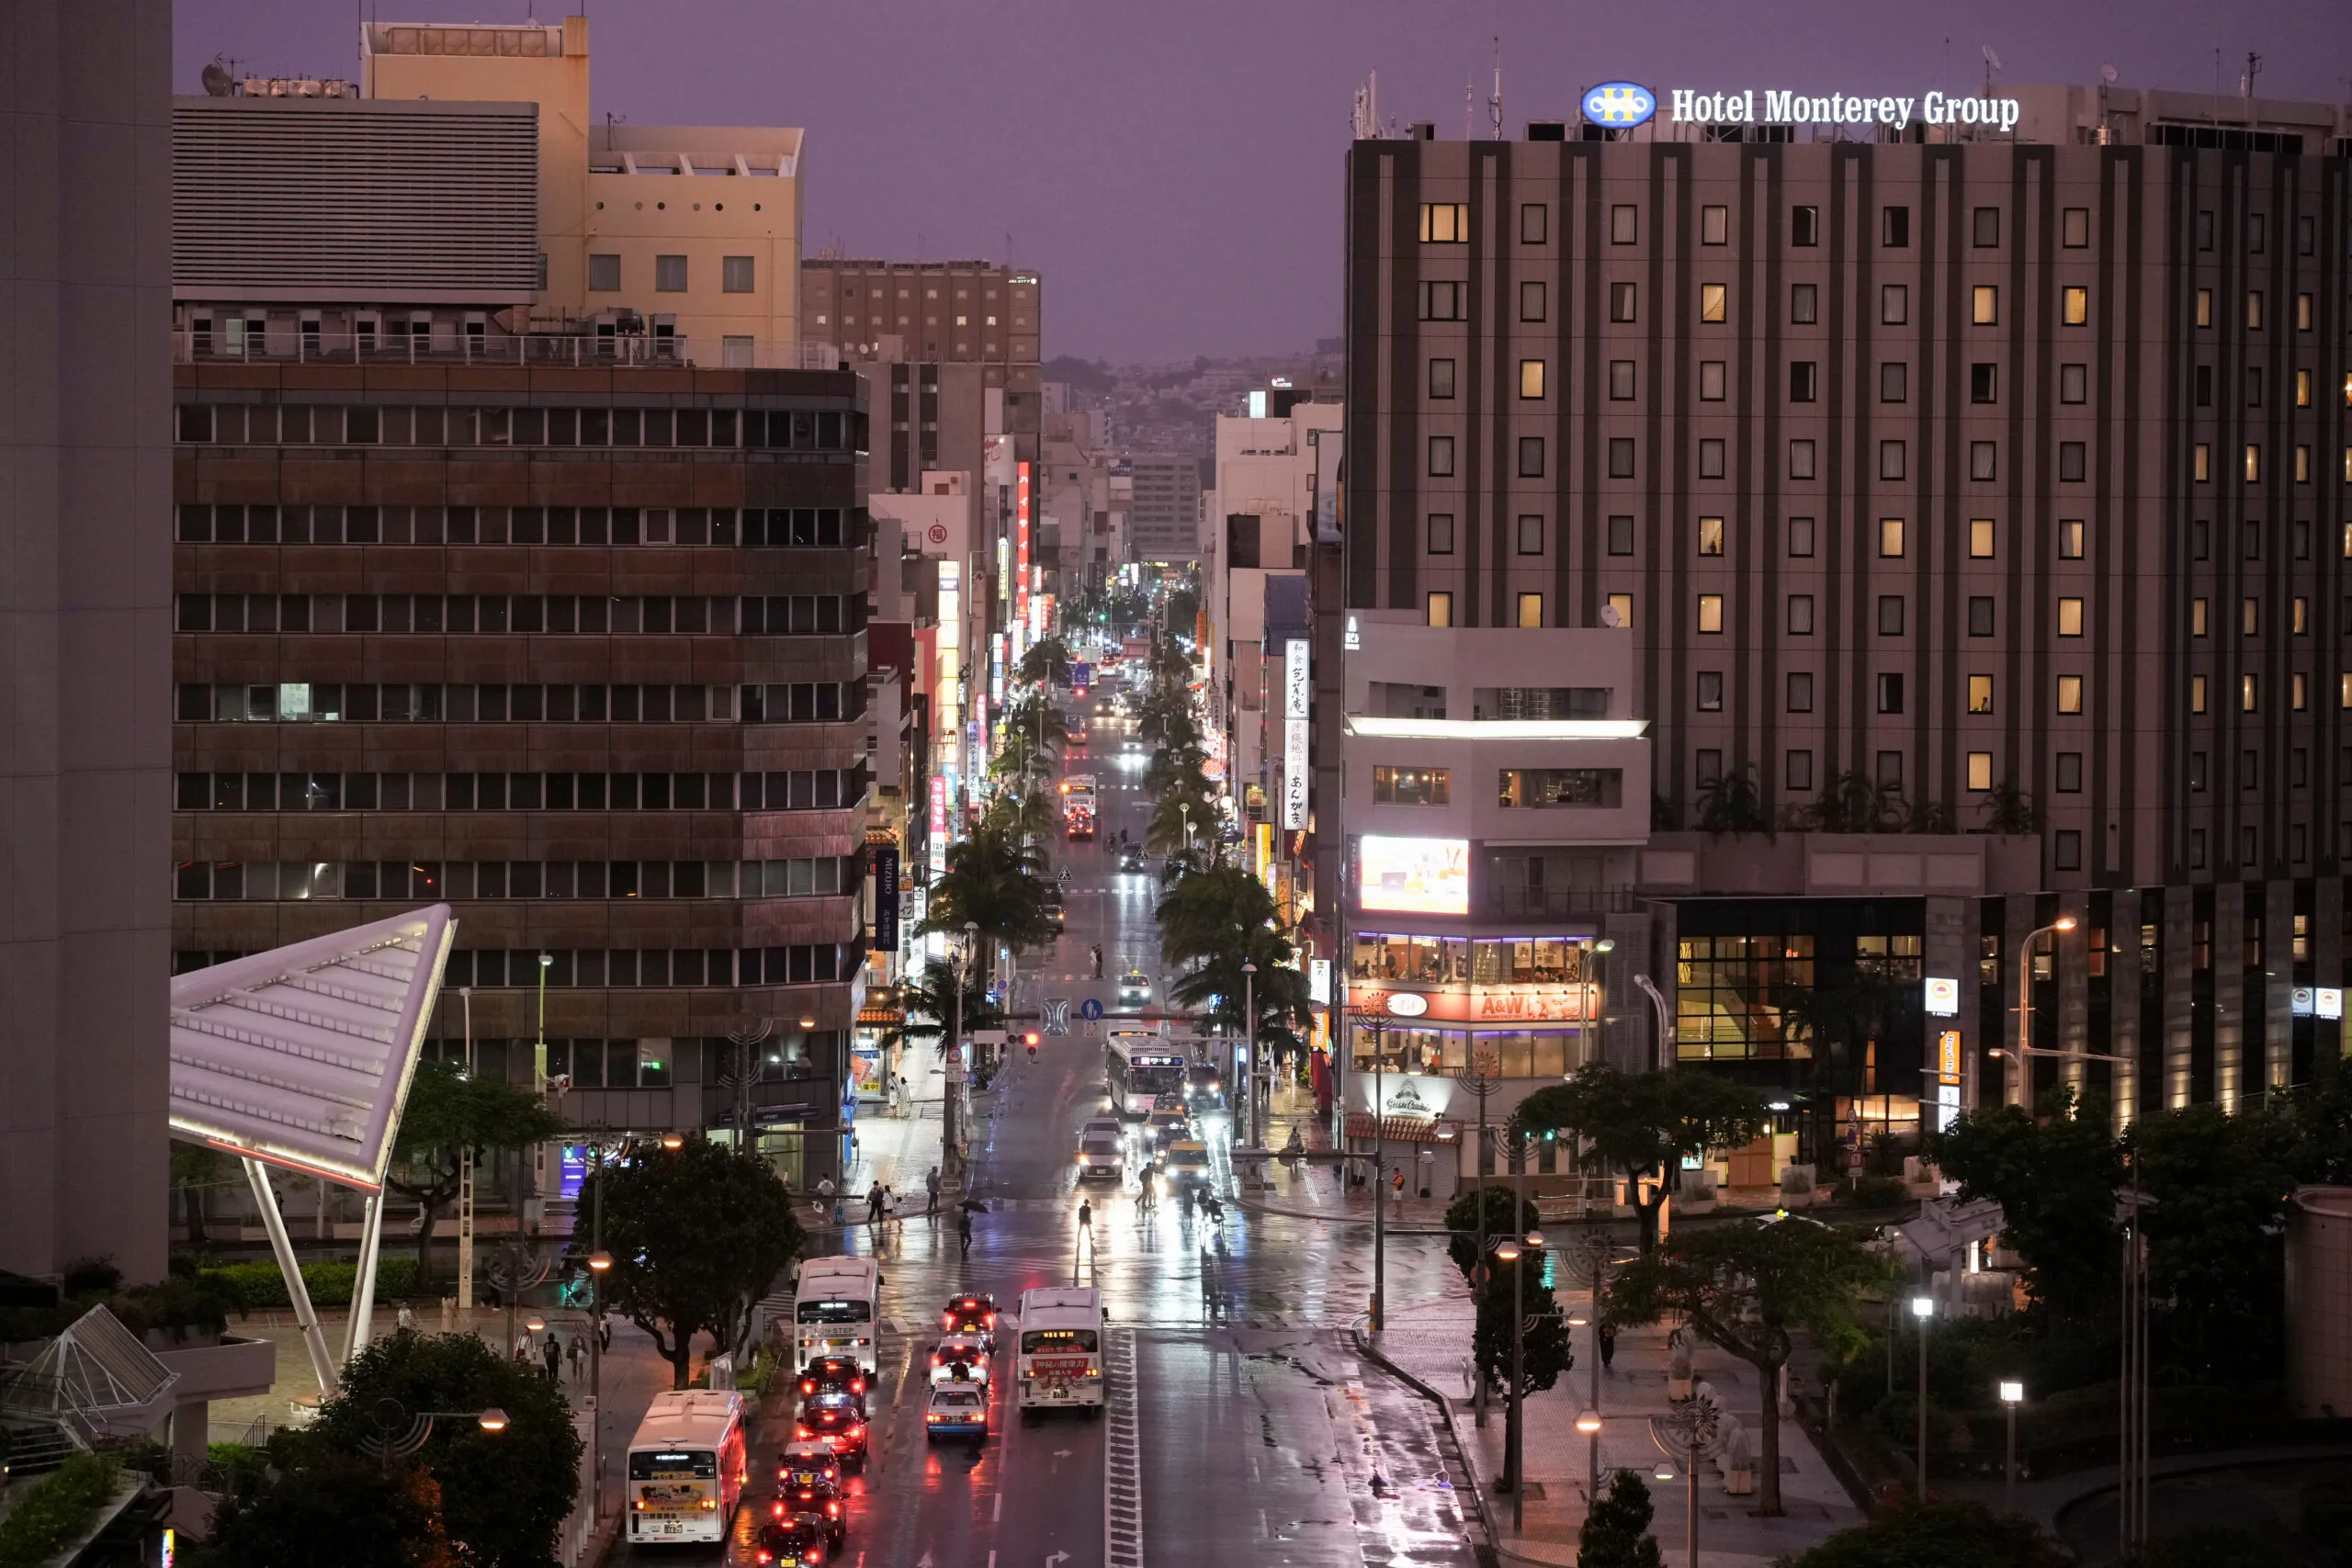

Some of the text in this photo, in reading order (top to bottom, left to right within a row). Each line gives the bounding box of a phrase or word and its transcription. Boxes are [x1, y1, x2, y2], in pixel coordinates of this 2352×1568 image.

[1672, 89, 2019, 131] Hotel Monterey Group
[932, 527, 944, 540] 福
[1019, 475, 1029, 593] ハイサイビル
[1293, 644, 1303, 665] 和食
[1290, 775, 1303, 825] あんがま
[885, 857, 893, 895] MIZUHO
[1482, 997, 1523, 1015] A&W
[1946, 1036, 1954, 1058] Royal
